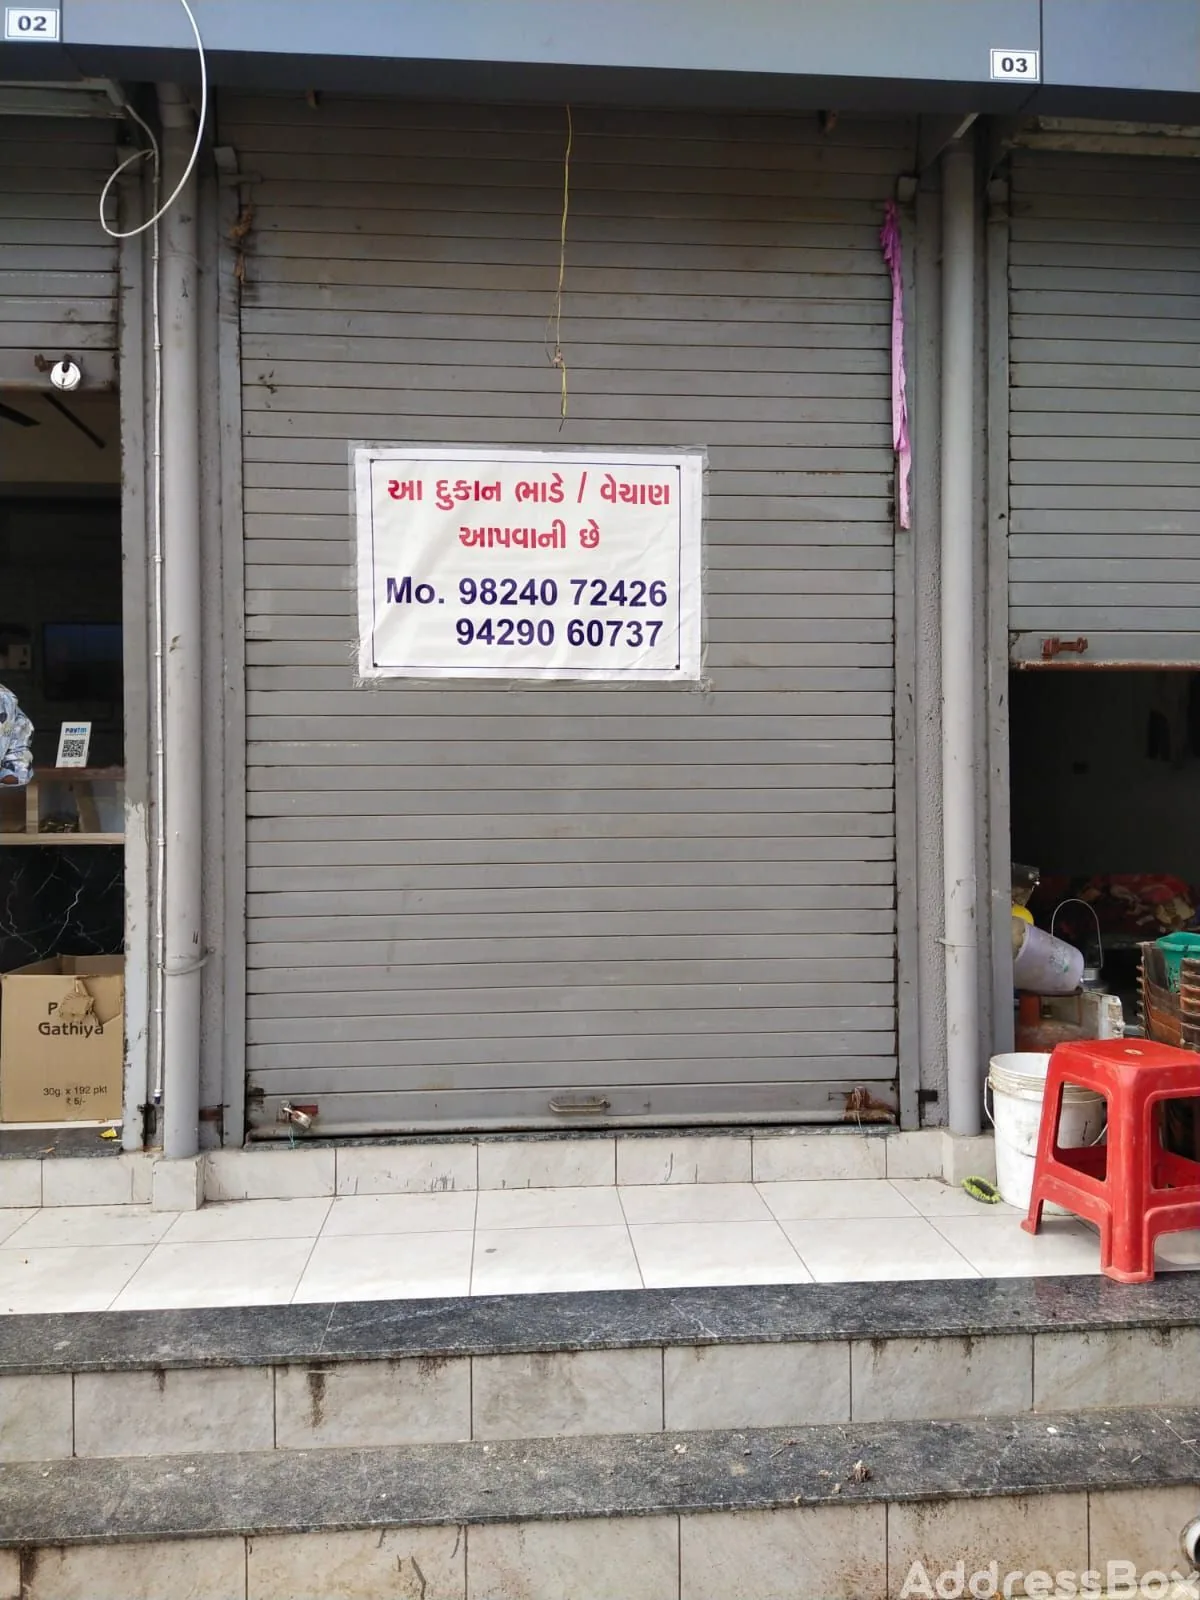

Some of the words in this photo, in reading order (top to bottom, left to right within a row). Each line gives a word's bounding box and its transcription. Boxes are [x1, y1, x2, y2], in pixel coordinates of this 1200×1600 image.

[18, 15, 47, 32] 02
[1001, 57, 1028, 73] 03
[387, 479, 423, 501] આ
[435, 478, 502, 511] દુકાન
[514, 472, 565, 504] ભાડે
[576, 471, 588, 503] /
[599, 473, 670, 506] વેચાણ
[458, 519, 566, 549] આપવાની
[579, 519, 601, 549] છે
[386, 576, 445, 605] Mo.
[458, 577, 558, 607] 98240
[569, 578, 668, 608] 72426
[455, 617, 555, 647] 94290
[566, 618, 664, 648] 60737
[38, 1021, 104, 1039] Gathiya
[74, 1085, 91, 1096] 192
[93, 1085, 107, 1097] pkt
